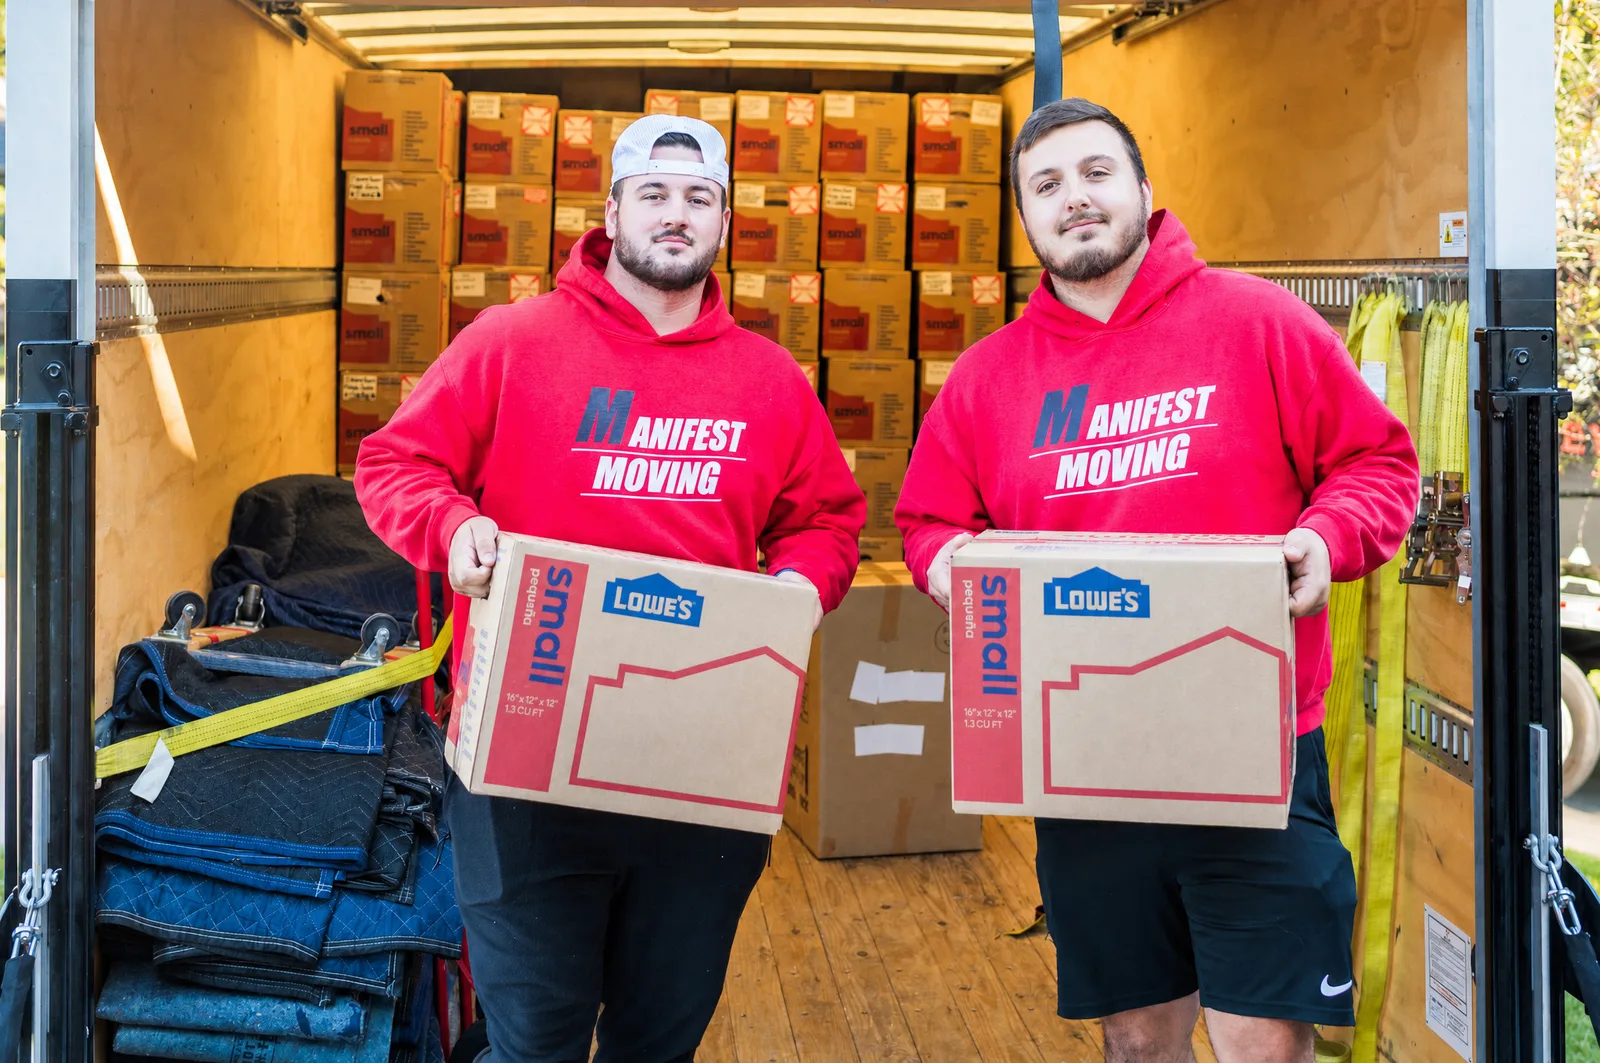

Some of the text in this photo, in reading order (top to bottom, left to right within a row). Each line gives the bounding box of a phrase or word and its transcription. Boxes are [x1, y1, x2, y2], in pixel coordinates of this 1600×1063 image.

[350, 124, 389, 136] small
[472, 141, 509, 153] small
[741, 139, 776, 150] small
[828, 139, 863, 150] small
[922, 141, 957, 151] small
[561, 158, 598, 169] small
[351, 226, 391, 238] small
[467, 231, 503, 243] small
[739, 227, 773, 239] small
[827, 227, 862, 240] small
[919, 229, 955, 241] small
[739, 317, 774, 329] small
[830, 315, 865, 328] small
[925, 317, 960, 329] small
[345, 327, 384, 339] small
[834, 406, 869, 417] small
[1033, 383, 1216, 449] MANIFEST
[575, 386, 747, 453] MANIFEST
[1055, 432, 1191, 490] MOVING
[592, 455, 722, 495] MOVING
[523, 567, 541, 627] pequeña
[613, 585, 694, 621] LOWE'S
[1054, 585, 1140, 613] LOWE'S
[962, 579, 977, 639] pequeña
[528, 564, 573, 686] small
[981, 574, 1018, 696] small
[505, 704, 545, 718] 1.3 CU FT
[964, 719, 1003, 729] 1.3 CU FT
